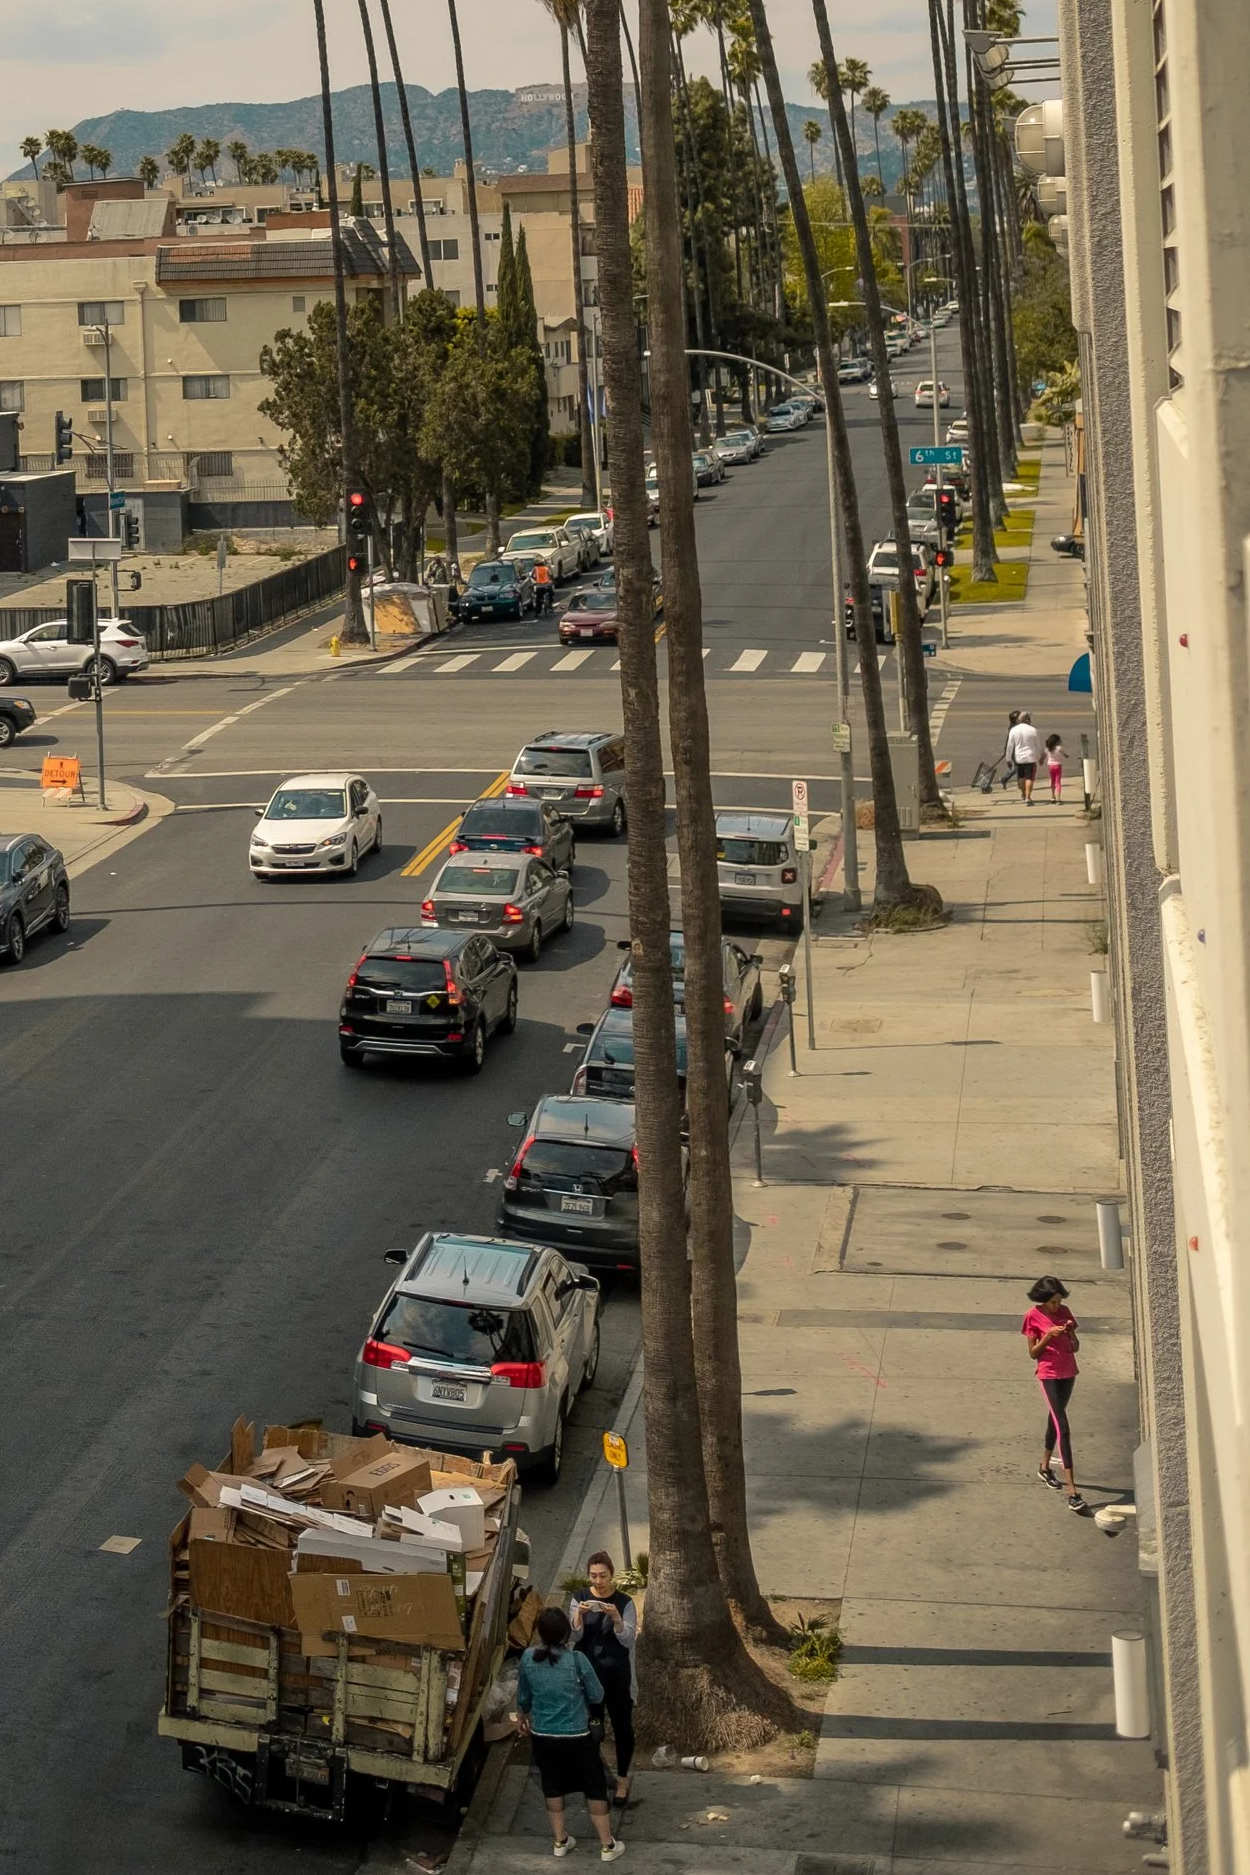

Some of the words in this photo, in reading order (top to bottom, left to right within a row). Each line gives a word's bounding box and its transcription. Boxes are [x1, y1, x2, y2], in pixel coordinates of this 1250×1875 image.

[915, 449, 934, 462] 6th
[945, 451, 957, 460] St
[44, 769, 75, 778] DETOUR
